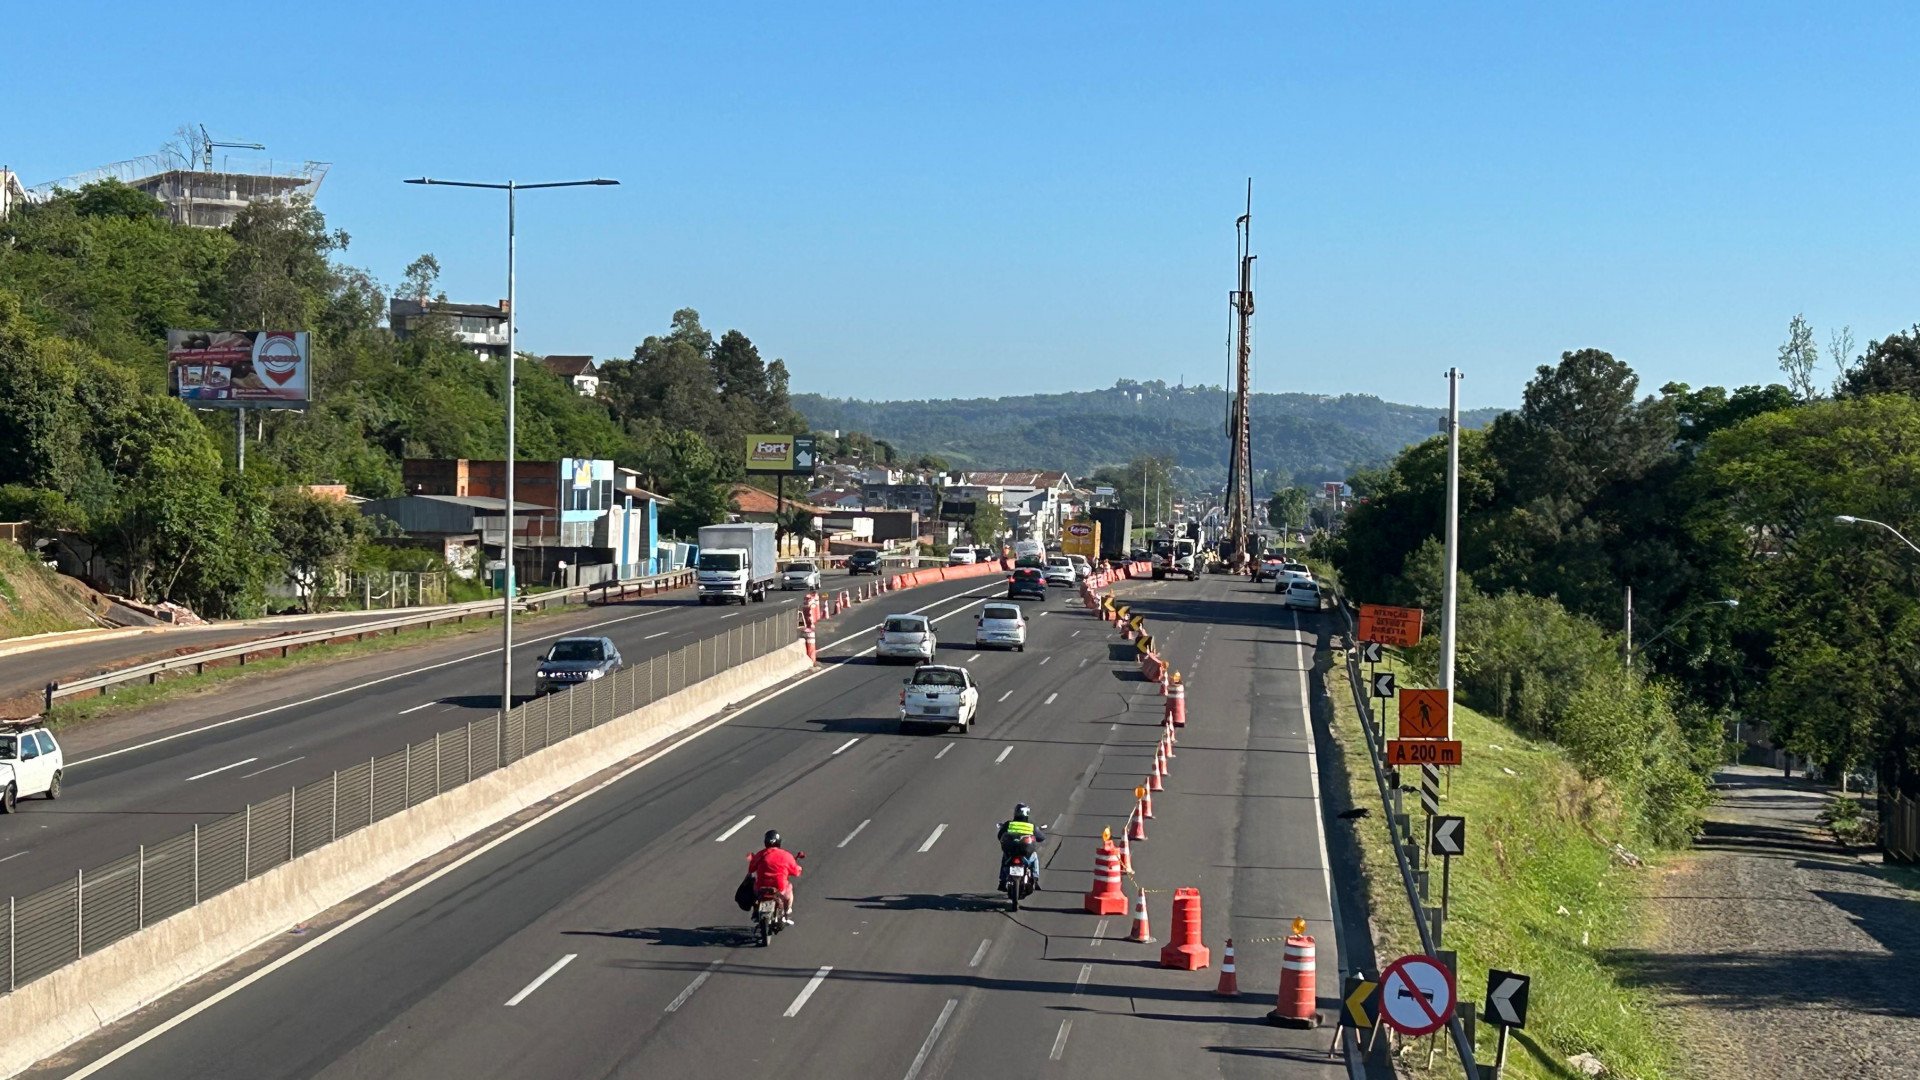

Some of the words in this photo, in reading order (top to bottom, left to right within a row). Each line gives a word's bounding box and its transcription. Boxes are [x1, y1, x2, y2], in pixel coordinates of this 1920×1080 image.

[757, 442, 786, 453] Fort
[1396, 744, 1406, 761] A
[1410, 744, 1436, 761] 200
[1441, 749, 1453, 761] m
